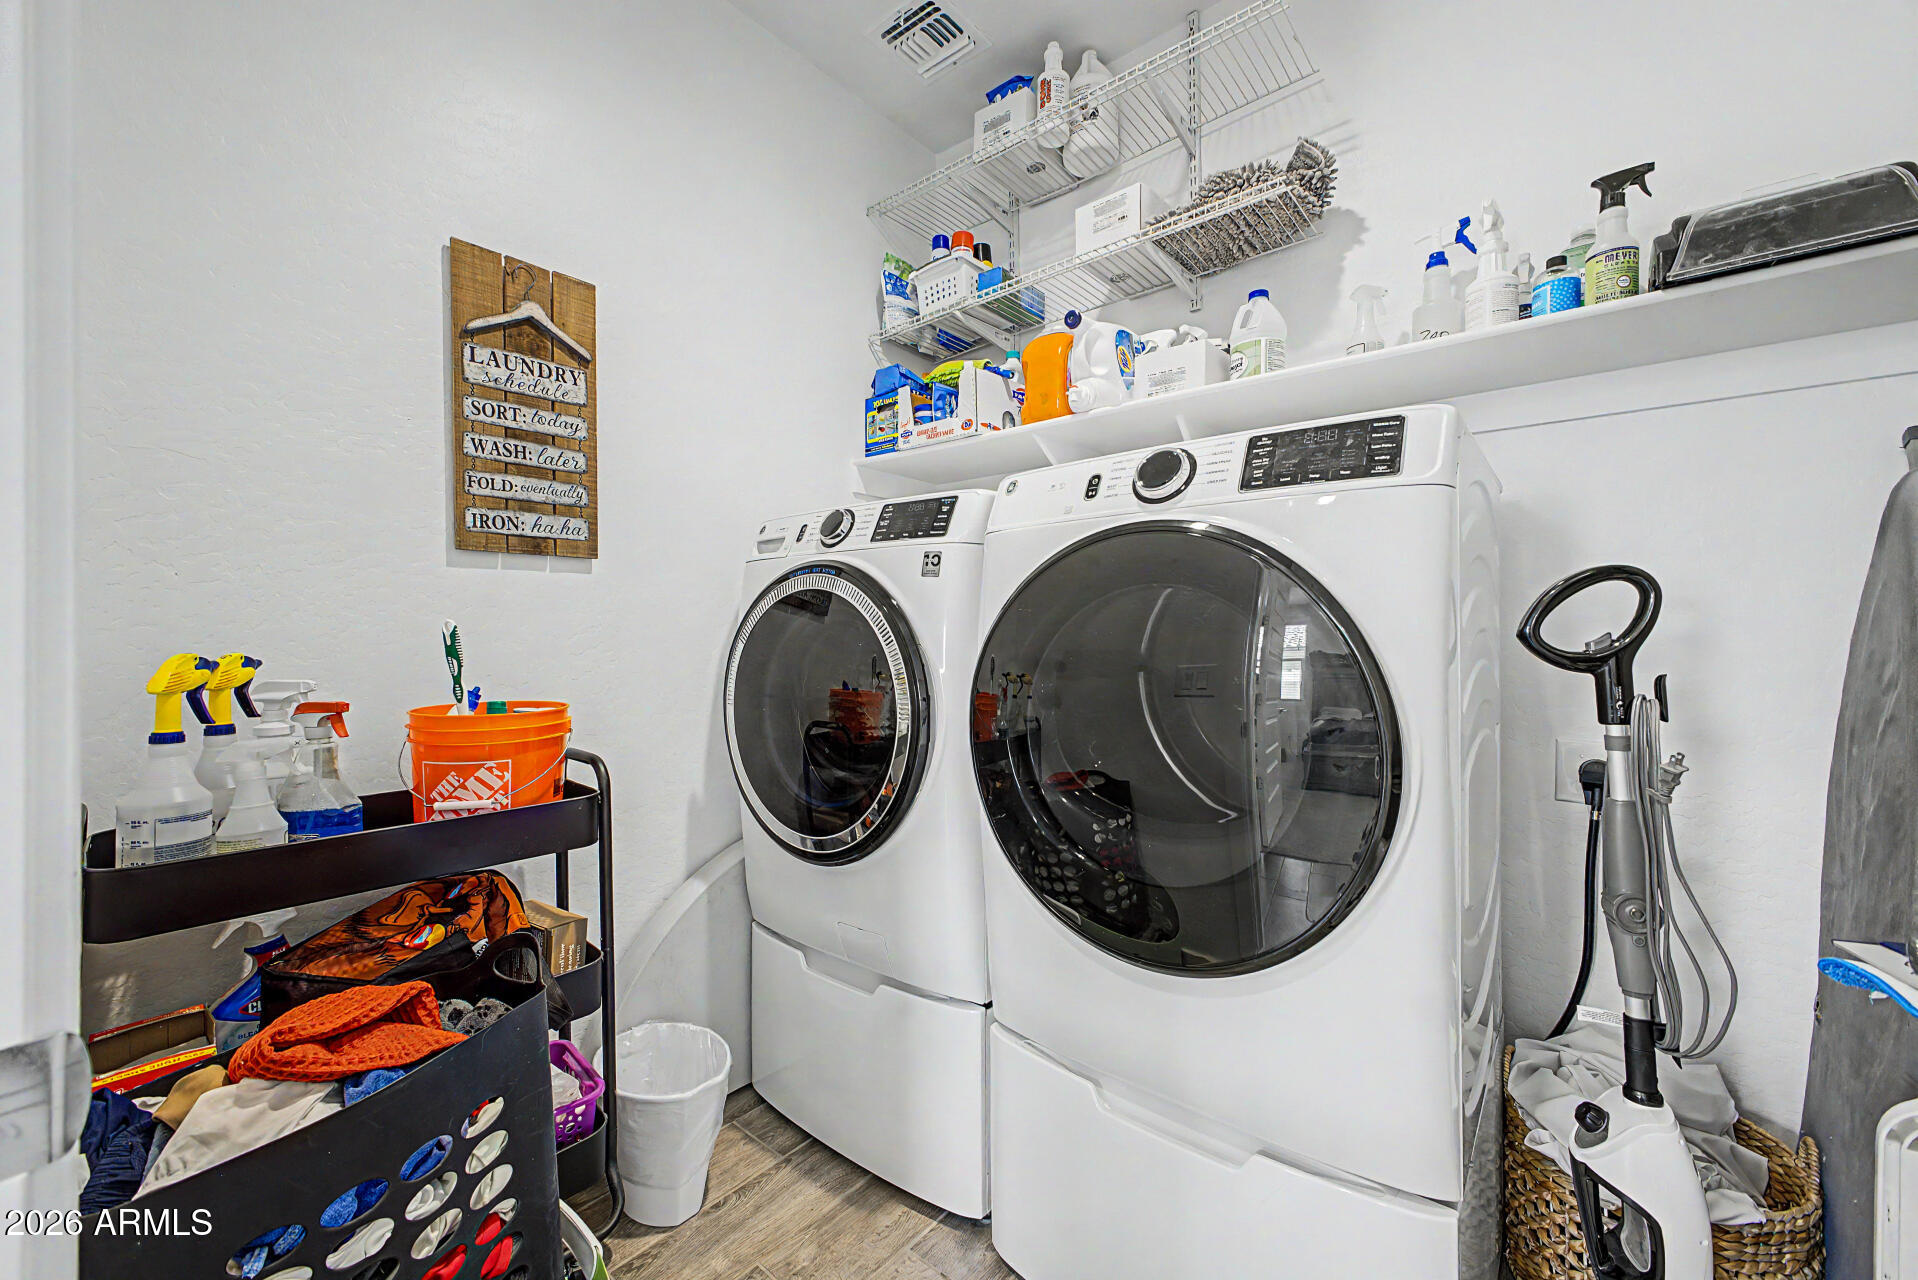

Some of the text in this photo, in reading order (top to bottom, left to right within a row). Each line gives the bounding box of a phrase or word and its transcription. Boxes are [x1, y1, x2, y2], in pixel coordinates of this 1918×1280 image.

[468, 345, 581, 387] LAUNDRY
[482, 371, 570, 400] schedule
[470, 400, 582, 436] SORT: today
[470, 437, 582, 470] WASH: later
[467, 475, 584, 504] FOLD: eventually
[471, 512, 525, 532] IRON:
[430, 771, 464, 802] THE
